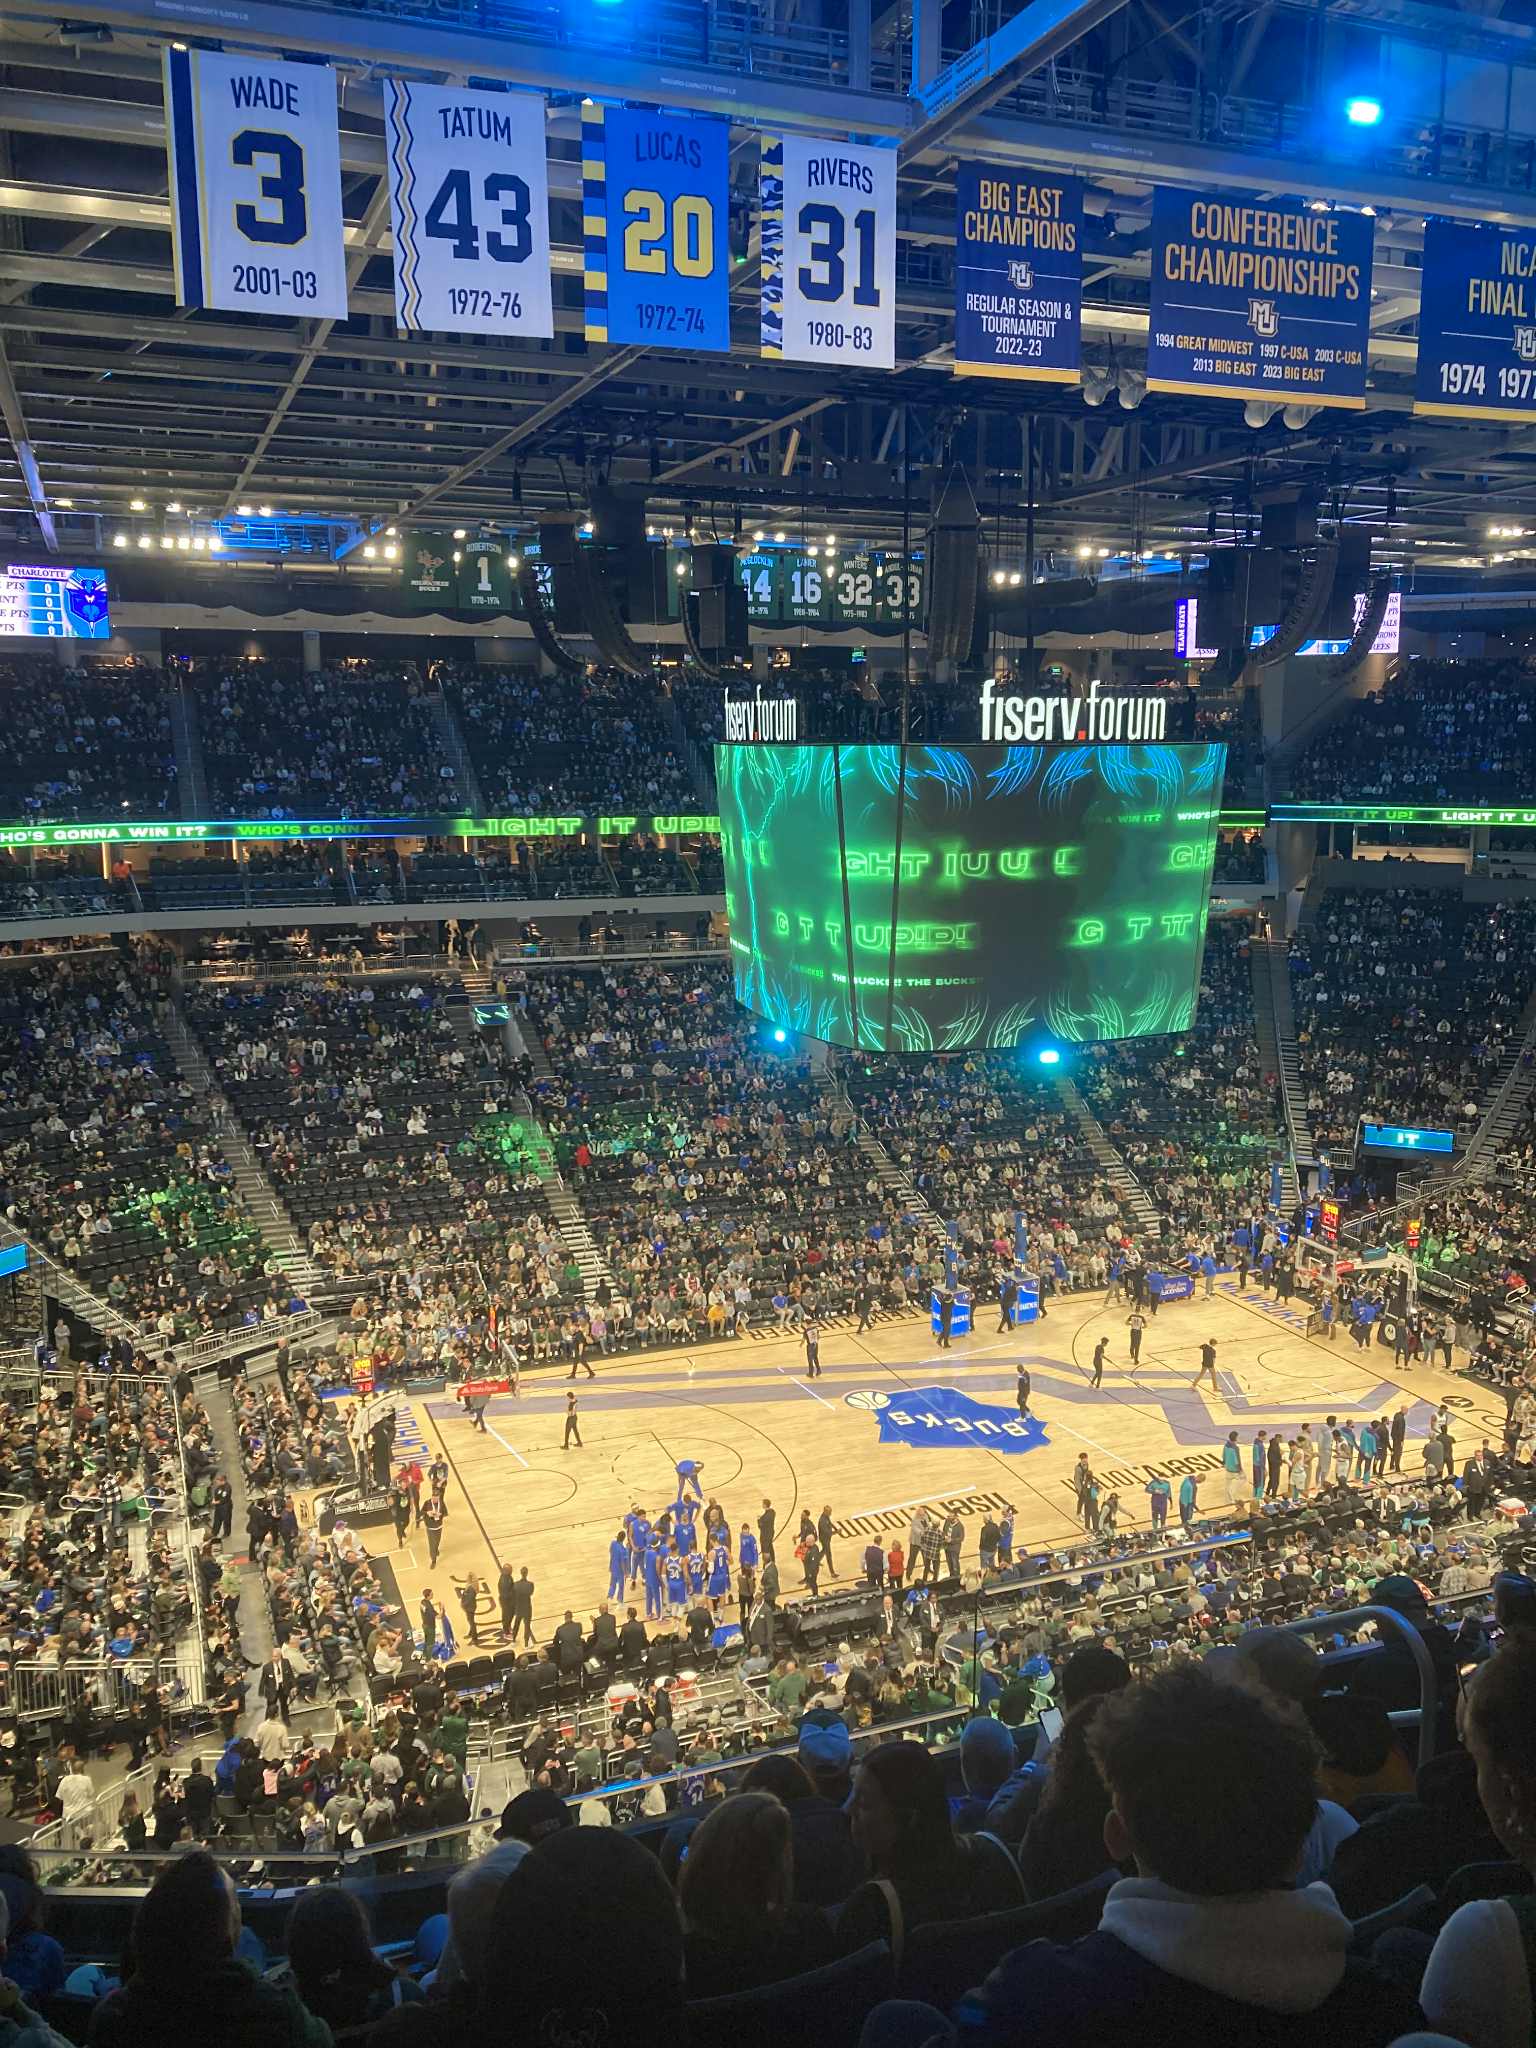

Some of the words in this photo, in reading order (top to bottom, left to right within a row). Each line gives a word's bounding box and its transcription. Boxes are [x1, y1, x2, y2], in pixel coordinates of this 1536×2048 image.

[230, 76, 300, 116] WADE
[439, 107, 513, 147] TATUM
[635, 131, 701, 169] LUCAS
[230, 127, 309, 247] 3
[807, 157, 874, 195] RIVERS
[979, 179, 1010, 213] BIG
[1016, 184, 1063, 219] EAST
[425, 168, 533, 264] 43
[1191, 201, 1339, 256] CONFERENCE
[622, 189, 715, 279] 20
[965, 211, 1076, 253] CHAMPIONS
[798, 202, 881, 308] 31
[233, 264, 317, 299] 2001-03
[1164, 243, 1360, 301] CHAMPIONSHIPS
[448, 288, 522, 319] 1972-76
[966, 293, 1016, 315] REGULAR
[1018, 299, 1062, 319] SEASON
[1064, 303, 1072, 320] &
[1468, 278, 1528, 318] FINAL
[636, 303, 706, 335] 1972-74
[981, 315, 1056, 338] TOURNAMENT
[807, 321, 873, 351] 1980-83
[995, 337, 1042, 357] 2022-23
[1155, 333, 1174, 348] 1994
[1176, 335, 1207, 351] GREAT
[1208, 338, 1254, 355] MIDWEST
[1259, 344, 1279, 358] 1997
[1280, 346, 1309, 361] C-USA
[1314, 348, 1334, 363] 2003
[1335, 350, 1362, 365] C-USA
[1193, 358, 1213, 372] 2013
[1215, 360, 1232, 374] BIG
[1233, 362, 1257, 376] EAST
[1262, 364, 1282, 379] 2023
[1284, 366, 1300, 380] BIG
[1302, 368, 1326, 382] EAST
[1440, 363, 1485, 395] 1974
[6, 581, 25, 590] PTS
[44, 583, 52, 593] 0
[11, 567, 67, 578] CHARLOTTE
[477, 556, 492, 591] 1
[791, 571, 822, 604] 16
[45, 597, 53, 607] 0
[838, 573, 873, 605] 32
[11, 609, 29, 617] PTS
[47, 611, 54, 621] 0
[48, 625, 55, 635] 0
[1178, 604, 1186, 629] STATS
[1177, 630, 1185, 652] TEAM
[462, 818, 581, 836] LIGHT
[600, 817, 635, 834] IT
[1363, 810, 1379, 819] IT
[1386, 810, 1414, 820] UP!
[1442, 811, 1493, 821] LIGHT
[1499, 812, 1516, 822] IT
[54, 828, 120, 841] GONNA
[129, 826, 169, 839] WIN
[176, 825, 207, 837] IT?
[239, 825, 302, 836] WHO'S
[906, 978, 931, 987] THE
[1397, 1132, 1420, 1145] IT
[888, 1411, 1030, 1437] BUCKS
[668, 1566, 681, 1580] 34
